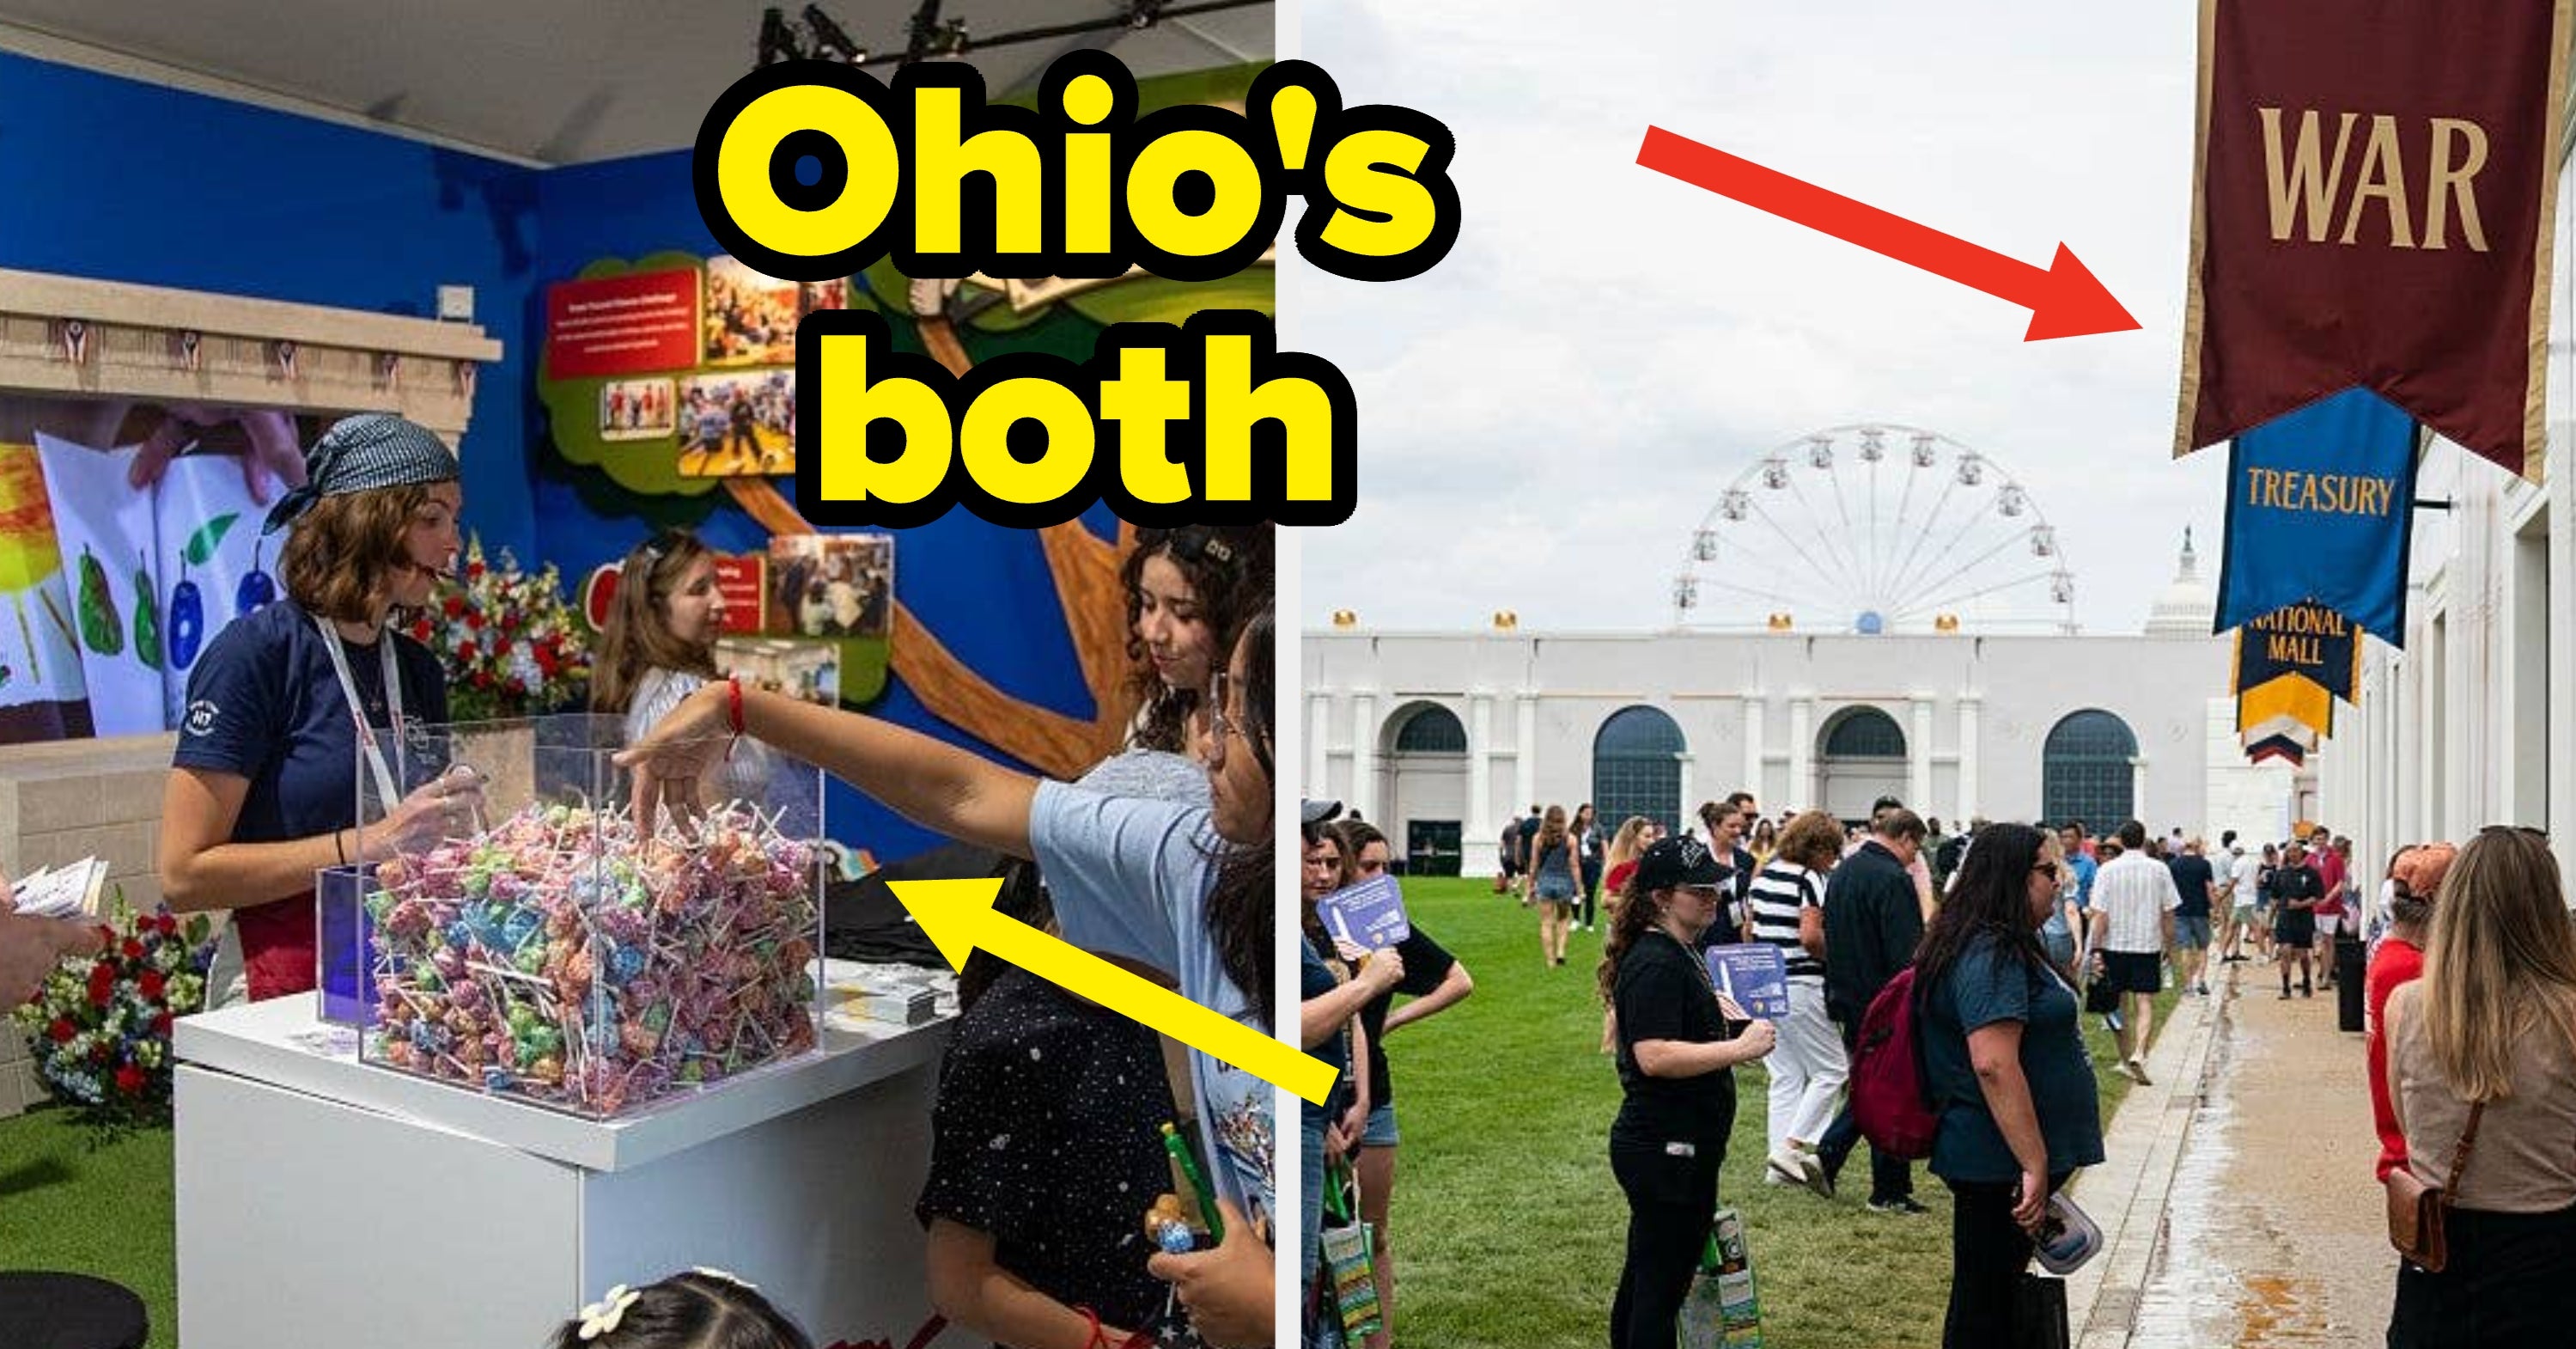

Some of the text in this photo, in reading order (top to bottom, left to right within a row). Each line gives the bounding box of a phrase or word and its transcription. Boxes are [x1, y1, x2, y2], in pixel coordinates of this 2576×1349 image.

[2258, 107, 2488, 252] WAR
[2248, 467, 2394, 516] TREASURY
[2268, 634, 2324, 665] MALL
